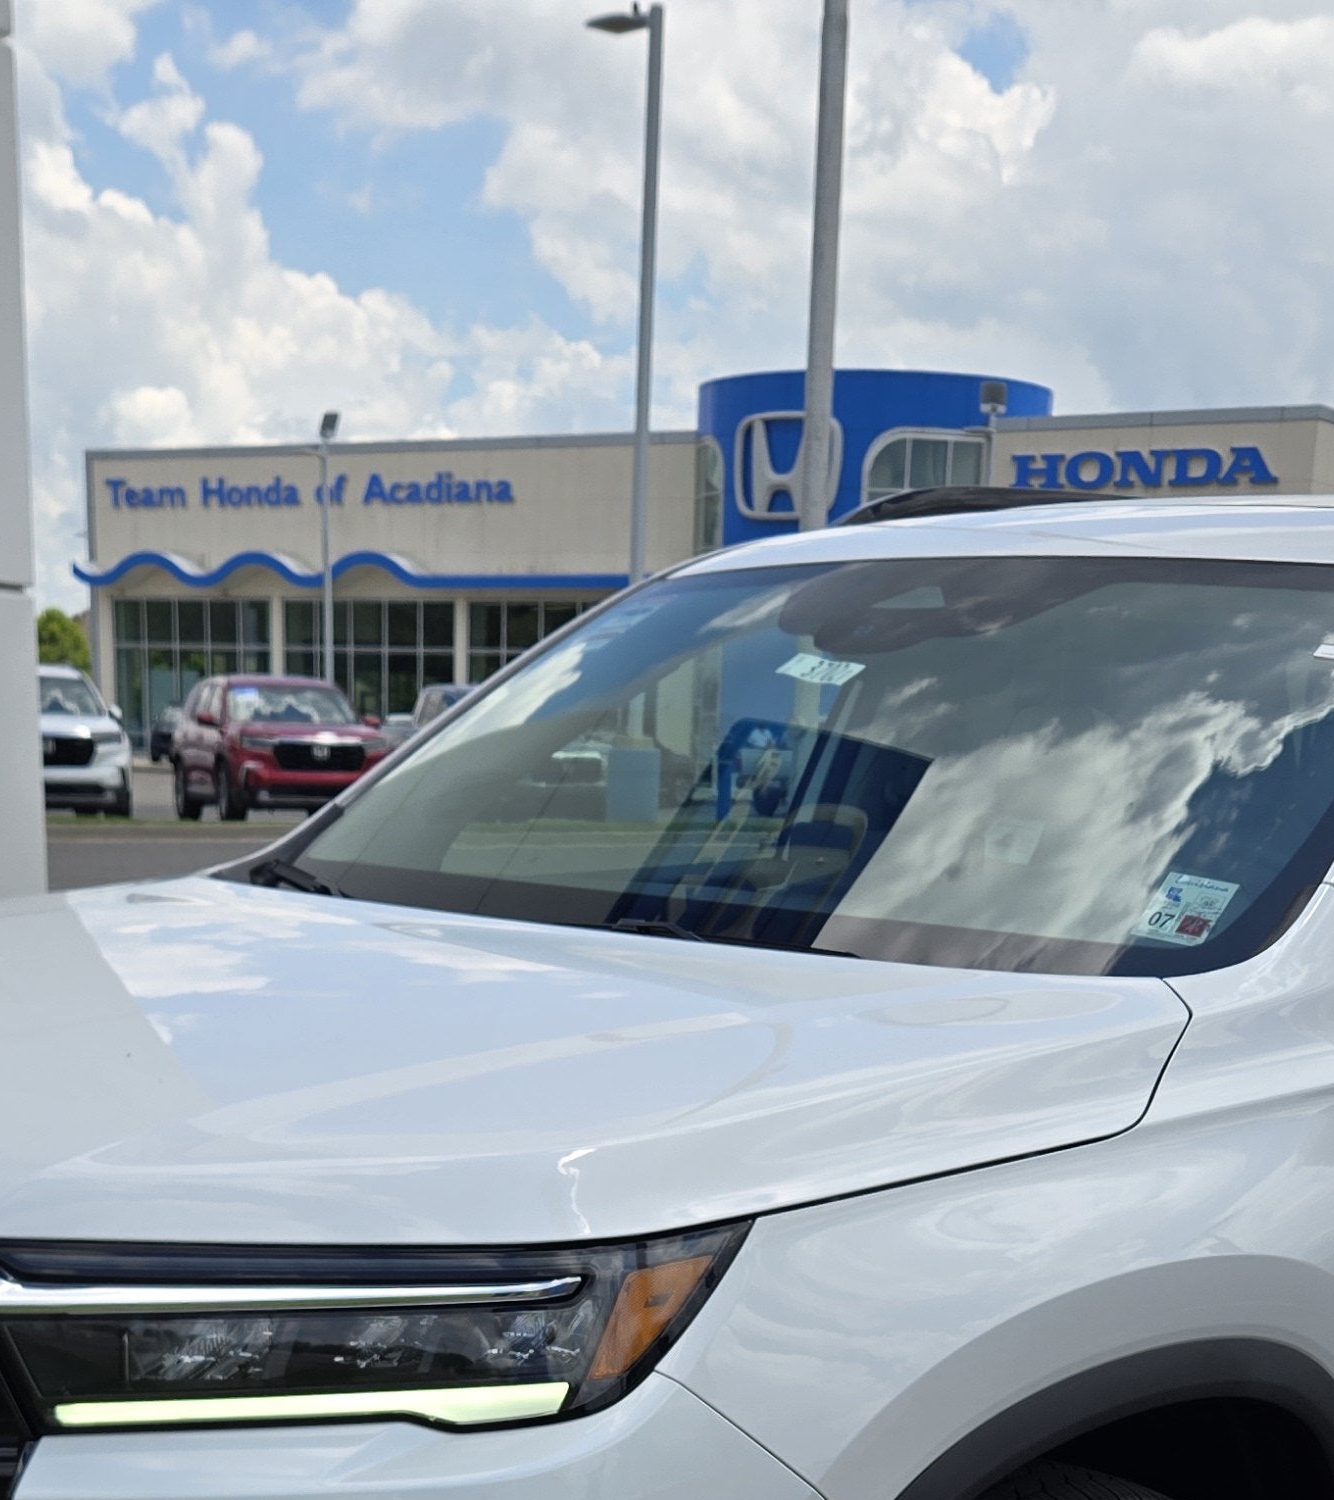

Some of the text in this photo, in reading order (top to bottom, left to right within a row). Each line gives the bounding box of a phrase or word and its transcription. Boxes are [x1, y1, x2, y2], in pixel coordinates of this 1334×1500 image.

[1010, 446, 1279, 490] HONDA
[105, 471, 514, 509] Team Honda of Acadiana
[1148, 911, 1176, 928] 07
